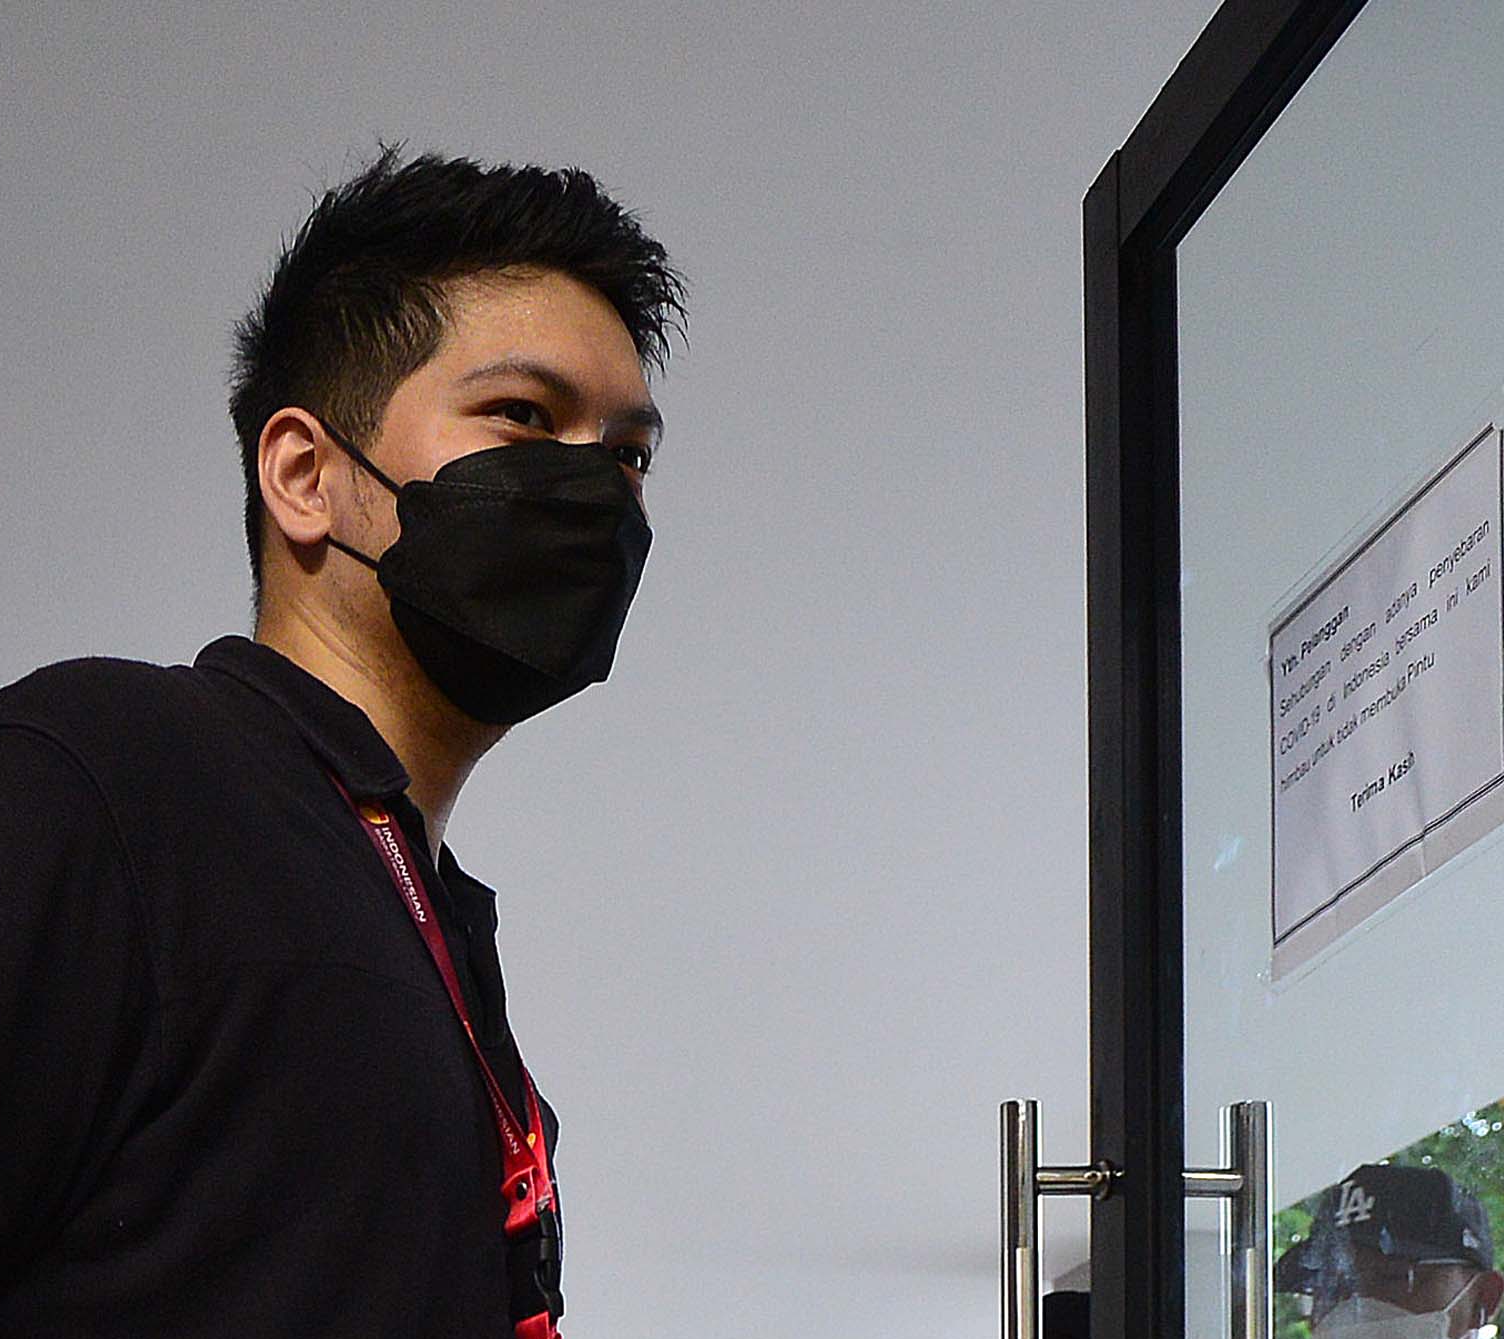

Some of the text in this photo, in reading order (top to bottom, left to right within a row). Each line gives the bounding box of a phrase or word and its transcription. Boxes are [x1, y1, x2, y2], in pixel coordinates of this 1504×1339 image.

[1279, 519, 1490, 718] Sehubungan dengan adanya penyebaran
[1279, 557, 1491, 755] COVID-19 di Indonesia bersama ini kami
[1300, 605, 1350, 661] Pelanggan
[1311, 736, 1336, 767] untuk
[1336, 713, 1359, 744] tidak
[1359, 674, 1407, 725] membuka
[1406, 651, 1436, 685] Pintu
[1350, 749, 1416, 813] Terima Kasih
[382, 826, 427, 923] INDONESIAN
[1334, 1179, 1377, 1228] LA
